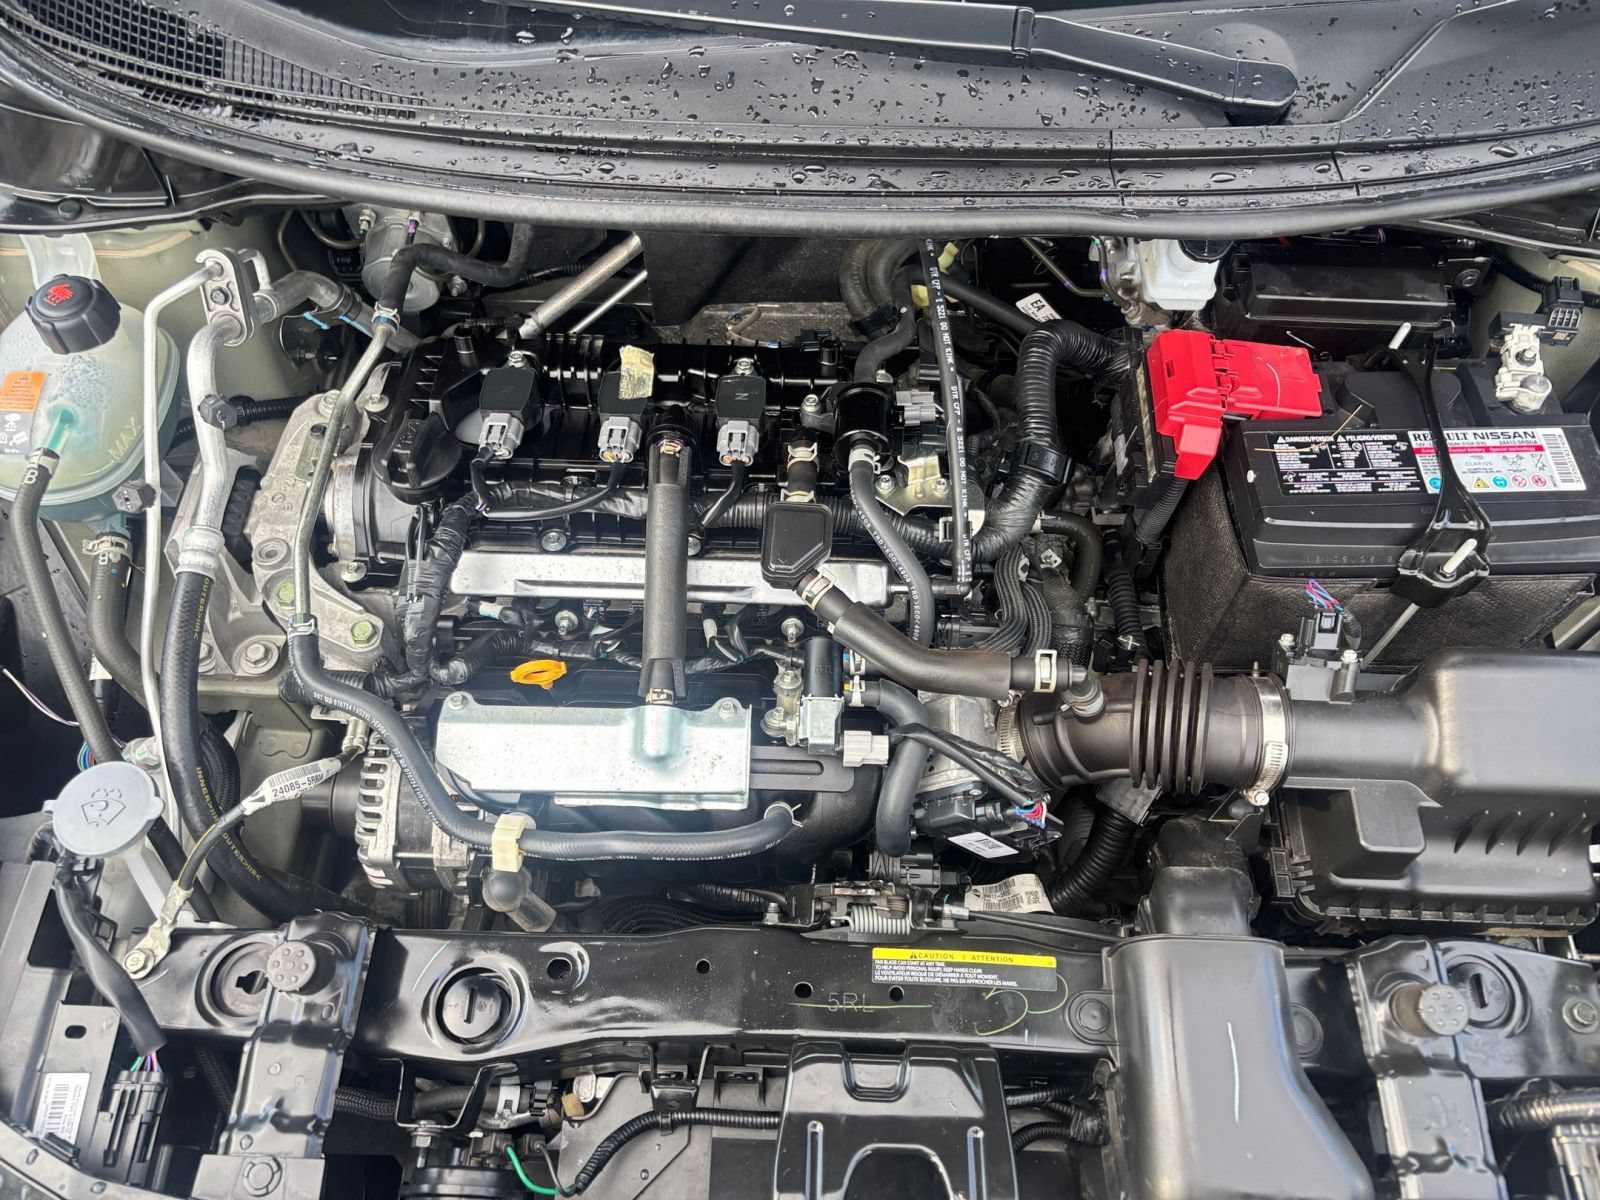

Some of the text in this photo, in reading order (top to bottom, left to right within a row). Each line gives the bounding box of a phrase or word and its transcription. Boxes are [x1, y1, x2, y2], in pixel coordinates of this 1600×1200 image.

[1030, 299, 1046, 312] EA
[945, 348, 954, 364] KINK
[108, 416, 141, 462] MAX
[1412, 430, 1537, 442] REULT NISSAN
[23, 469, 39, 484] B
[918, 952, 954, 960] CAUTION
[971, 955, 1014, 964] ATTENTION
[828, 992, 874, 1013] 5RL
